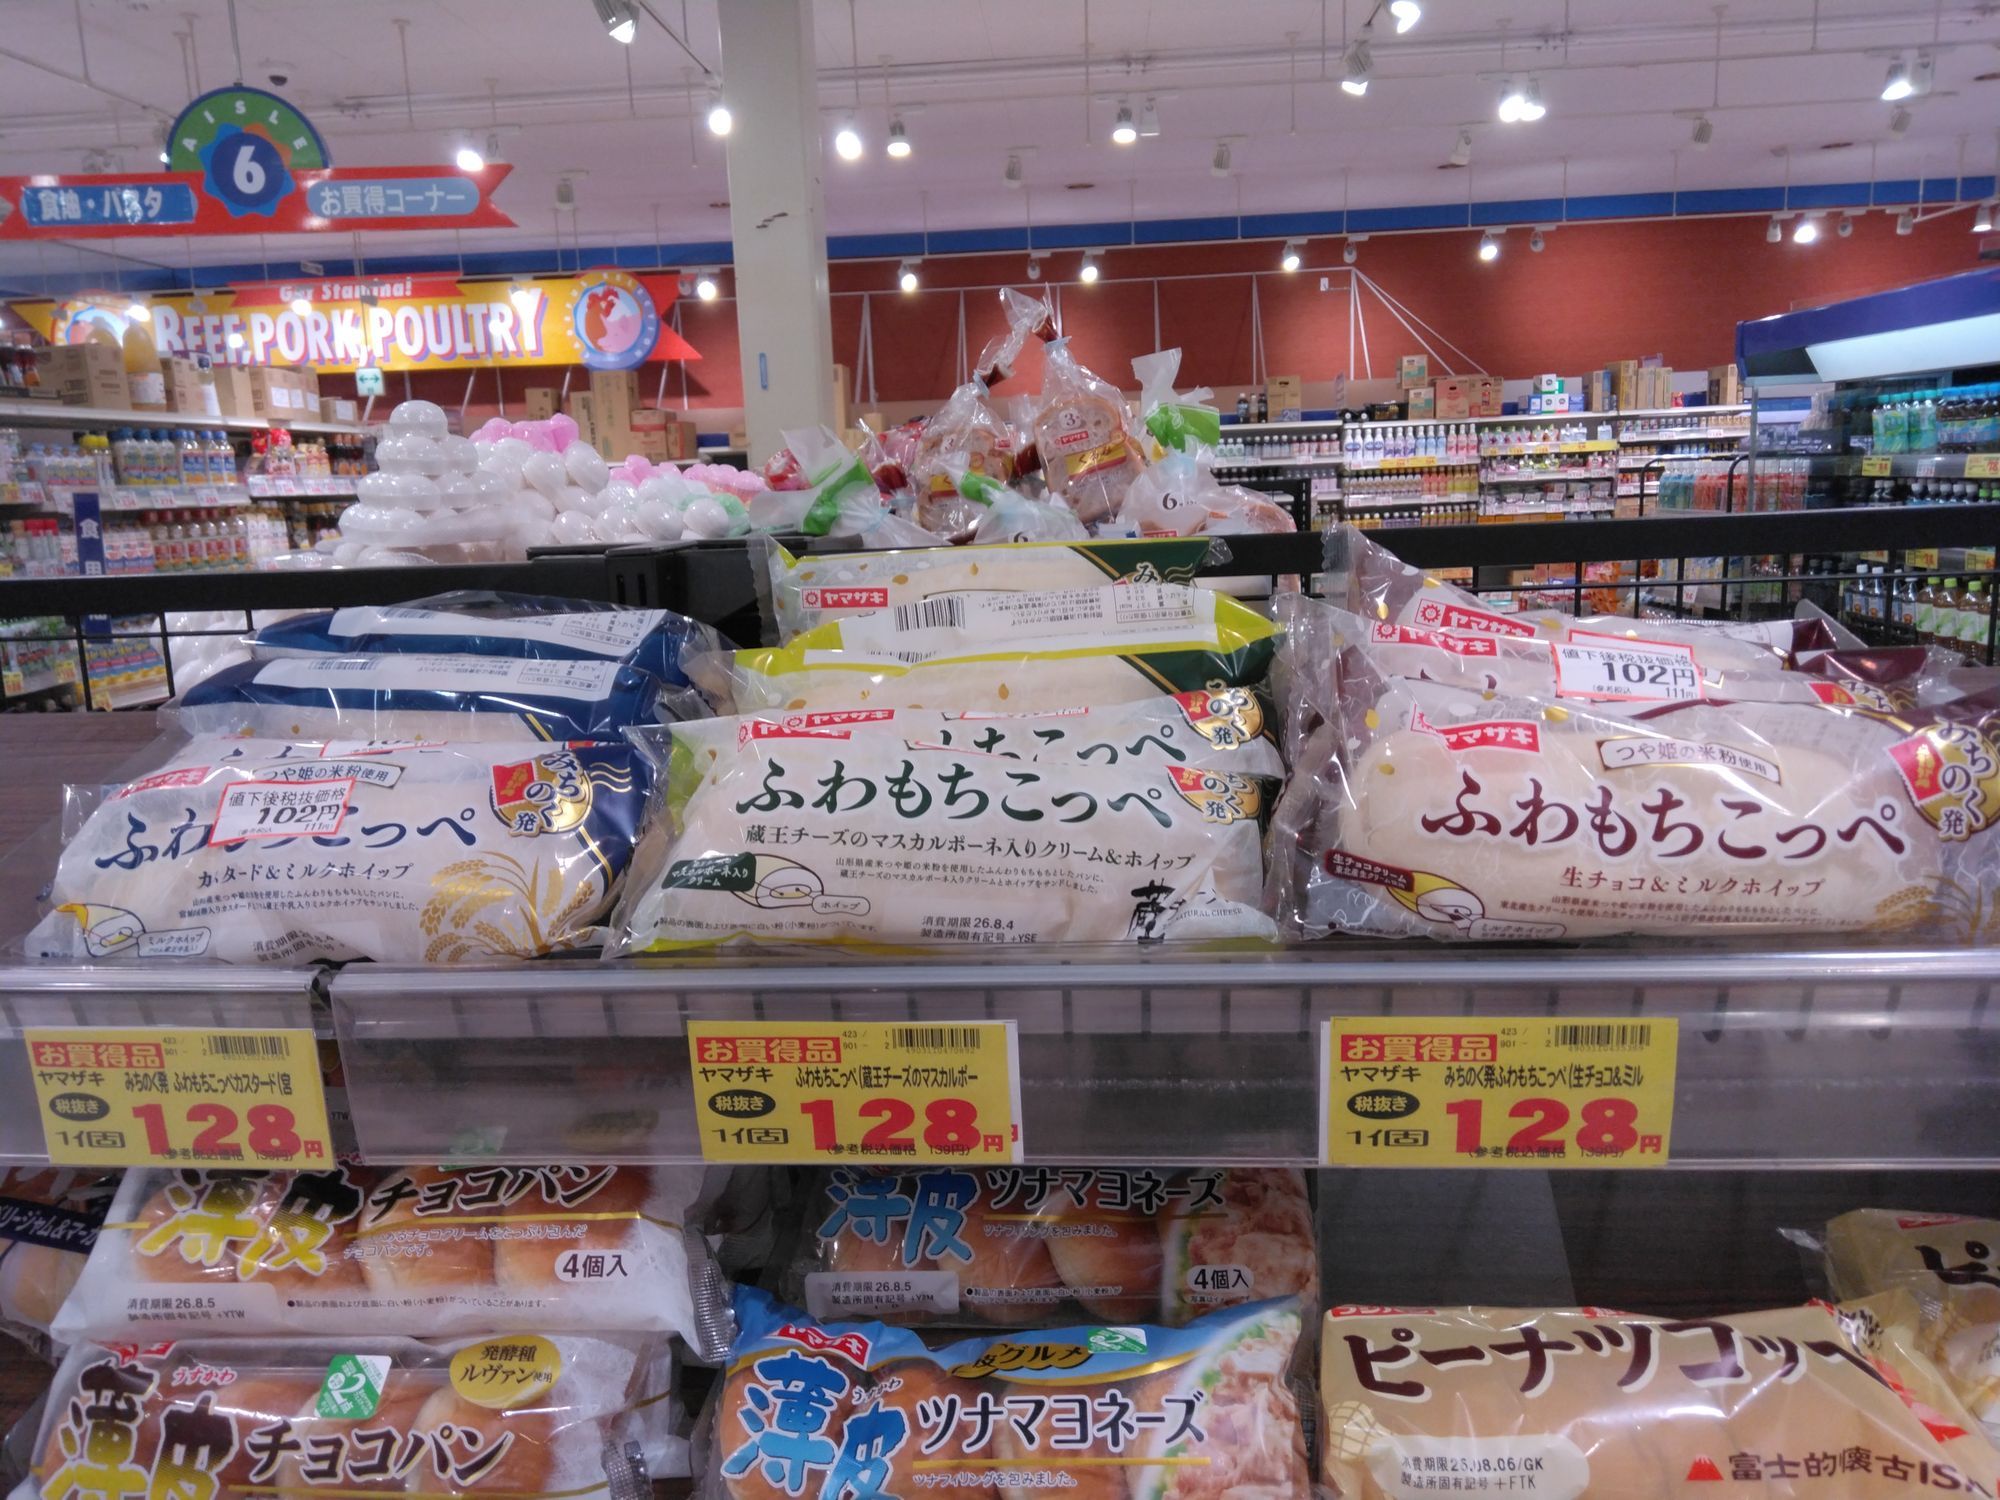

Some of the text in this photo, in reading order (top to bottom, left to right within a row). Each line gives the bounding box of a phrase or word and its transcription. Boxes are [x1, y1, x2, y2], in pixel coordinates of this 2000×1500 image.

[183, 100, 307, 151] AISLE
[233, 146, 266, 195] 6
[320, 185, 466, 215] お買得コーナー
[252, 306, 372, 366] PORK,
[370, 288, 543, 360] POULTRY
[1162, 493, 1178, 511] 6
[824, 592, 885, 605] ヤマザキ
[1448, 611, 1530, 637] ヤマザキ
[1408, 627, 1490, 653] ヤマザキ
[1602, 662, 1696, 688] 102円
[811, 710, 889, 726] ヤマザキ
[1615, 744, 1769, 776] つや姫の米粉使用
[262, 765, 389, 782] つや姫の米粉使用
[229, 787, 346, 807] 値下後税抜価格
[736, 757, 1173, 830] ふわもちこっぺ
[257, 803, 341, 825] 102円
[1421, 768, 1906, 860] ふわもちこっぺ
[745, 824, 1195, 871] 蔵王チーズのマスカルポーネ入りクリーム&ホイップ
[197, 862, 415, 890] カタード&ミルクホイップ
[1559, 866, 1826, 896] 生チョコ&ミルクホイップ
[820, 901, 862, 911] ホイップ
[922, 915, 1015, 930] 消費期限 26.8.4
[39, 1043, 161, 1068] お買得品
[703, 1037, 835, 1063] お買得品
[1347, 1036, 1491, 1061] お買得品
[38, 1070, 105, 1087] ヤマザキ
[699, 1066, 774, 1083] ヤマザキ
[1340, 1065, 1422, 1083] ヤマザキ
[55, 1098, 100, 1114] 税抜き
[715, 1096, 765, 1112] 税抜き
[1354, 1095, 1408, 1113] 税抜き
[711, 1127, 789, 1145] 1個
[1346, 1129, 1430, 1148] 1個
[364, 1165, 617, 1223] チョコパン
[989, 1166, 1225, 1213] ツナマヨネーズ
[343, 1243, 434, 1259] チョコパンです。
[561, 1253, 629, 1279] 4個入
[831, 1280, 913, 1293] 消費期限 26.8.5
[1192, 1267, 1250, 1291] 4個入
[127, 1297, 216, 1311] 消費期限 26.8.5
[479, 1345, 538, 1363] 発酵種
[173, 1366, 236, 1386] うすかわ
[40, 1356, 242, 1500] 薄皮
[246, 1417, 516, 1485] チョコパン
[721, 1350, 1206, 1500] 薄皮 ツナマヨネーズ
[912, 1473, 1078, 1490] ツナフィリングを包みました。
[1400, 1472, 1537, 1490] 製造所固有記号 +FTK
